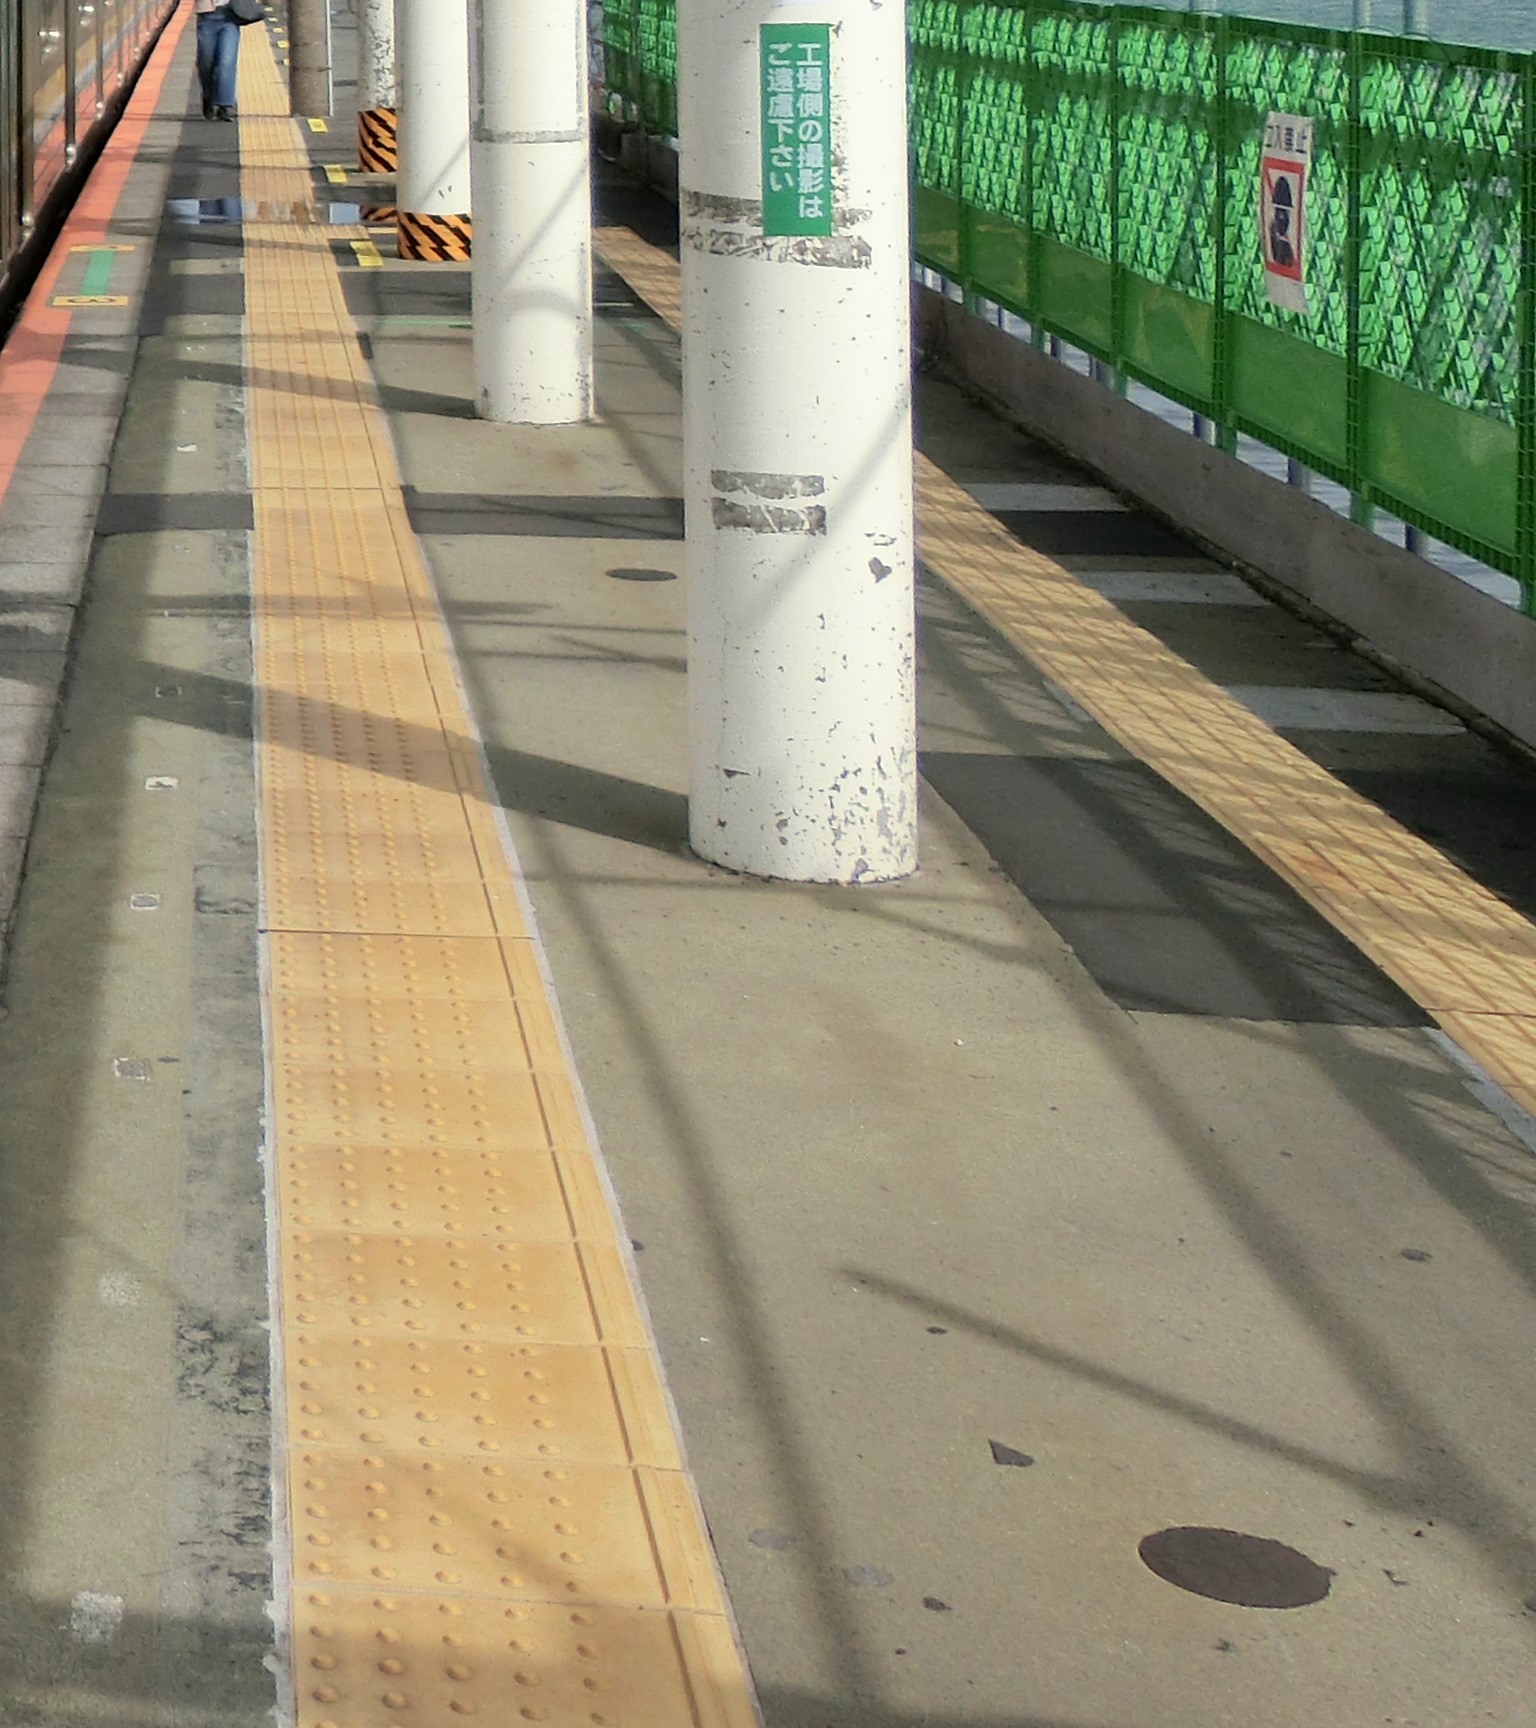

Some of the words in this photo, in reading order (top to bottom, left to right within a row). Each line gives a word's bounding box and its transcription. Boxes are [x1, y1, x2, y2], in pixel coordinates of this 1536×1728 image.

[767, 43, 795, 192] ご遠慮下さい
[796, 43, 824, 218] 工場側の撮影は
